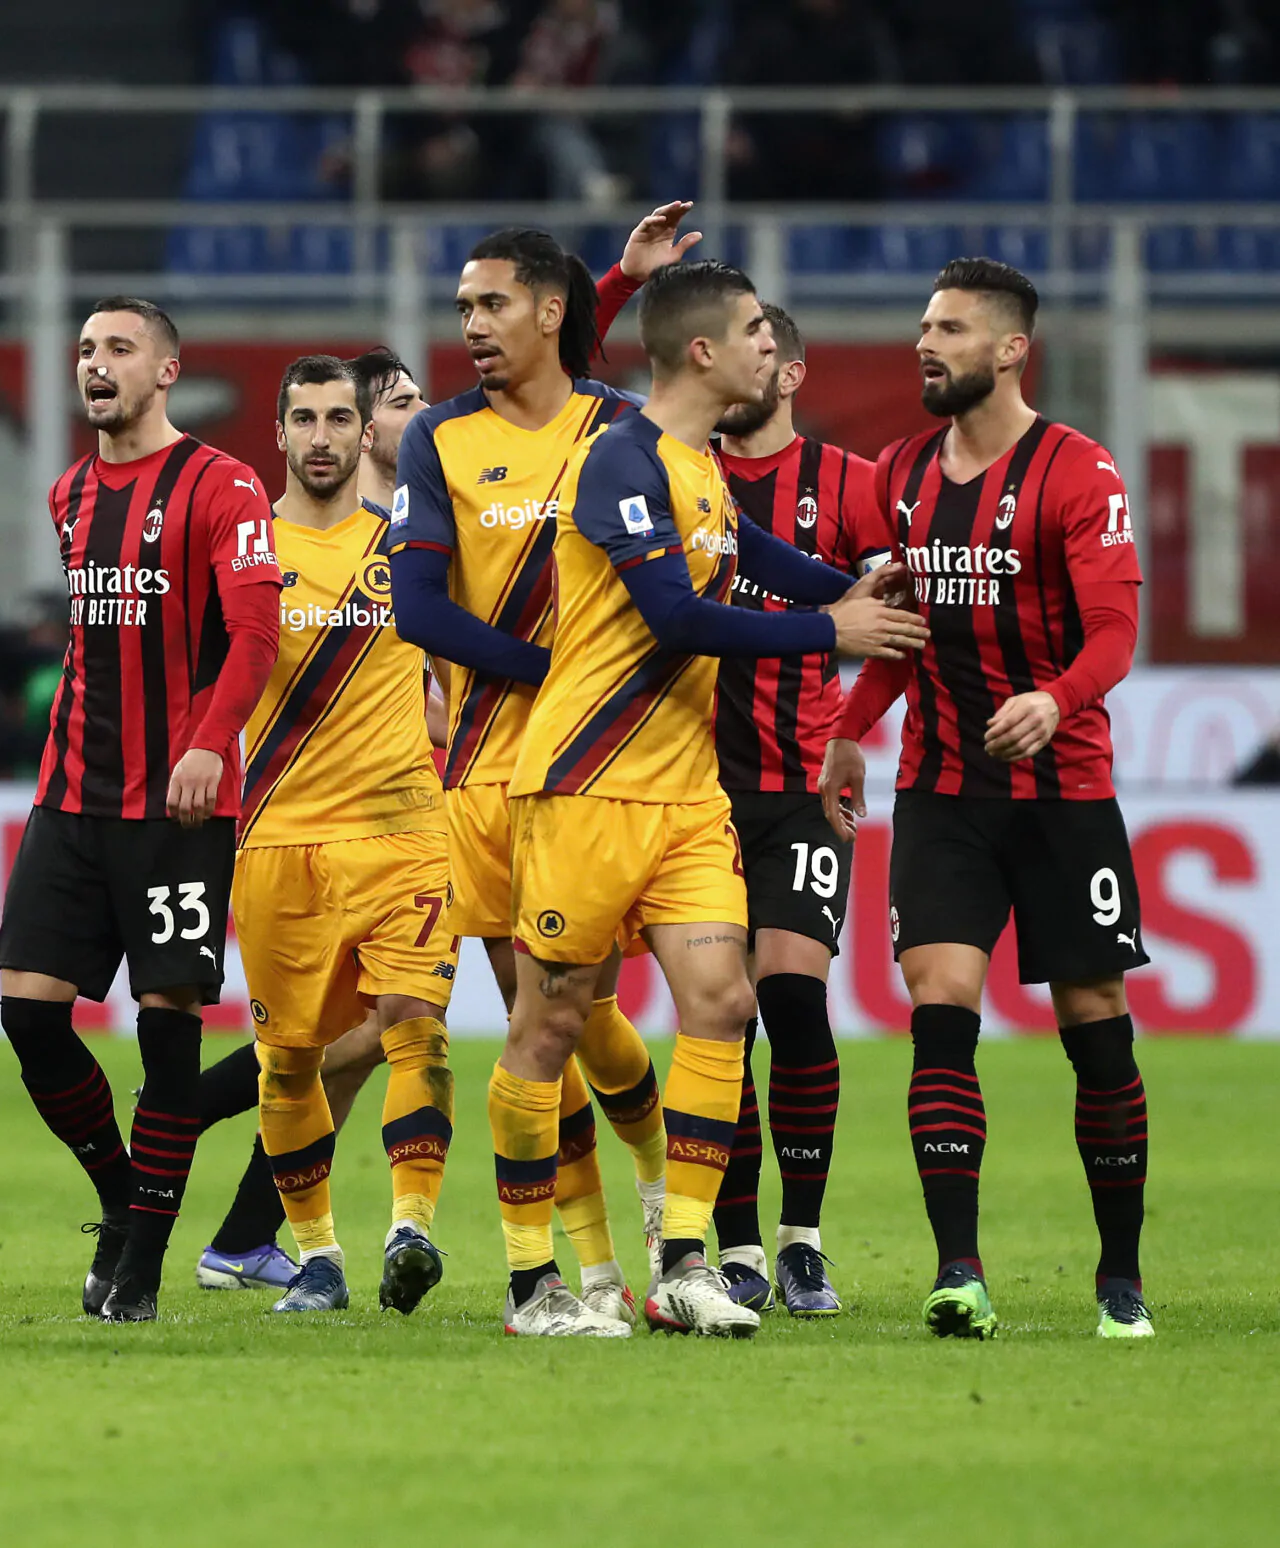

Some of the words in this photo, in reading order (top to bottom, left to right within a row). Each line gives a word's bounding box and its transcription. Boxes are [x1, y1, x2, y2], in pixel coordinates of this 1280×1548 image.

[479, 498, 559, 531] digita
[1100, 529, 1134, 548] BitM
[899, 538, 1022, 575] mirates
[63, 560, 171, 595] mirates
[935, 577, 1000, 605] BETTER
[87, 599, 147, 626] BETTER
[279, 602, 397, 632] igitalbit
[790, 842, 839, 899] 19
[1090, 867, 1121, 927] 9
[147, 881, 211, 944] 33
[670, 1141, 729, 1166] AS-RO
[781, 1146, 822, 1159] ACM
[923, 1142, 969, 1154] ACM
[1094, 1153, 1138, 1166] ACM
[500, 1181, 556, 1200] AS-RO
